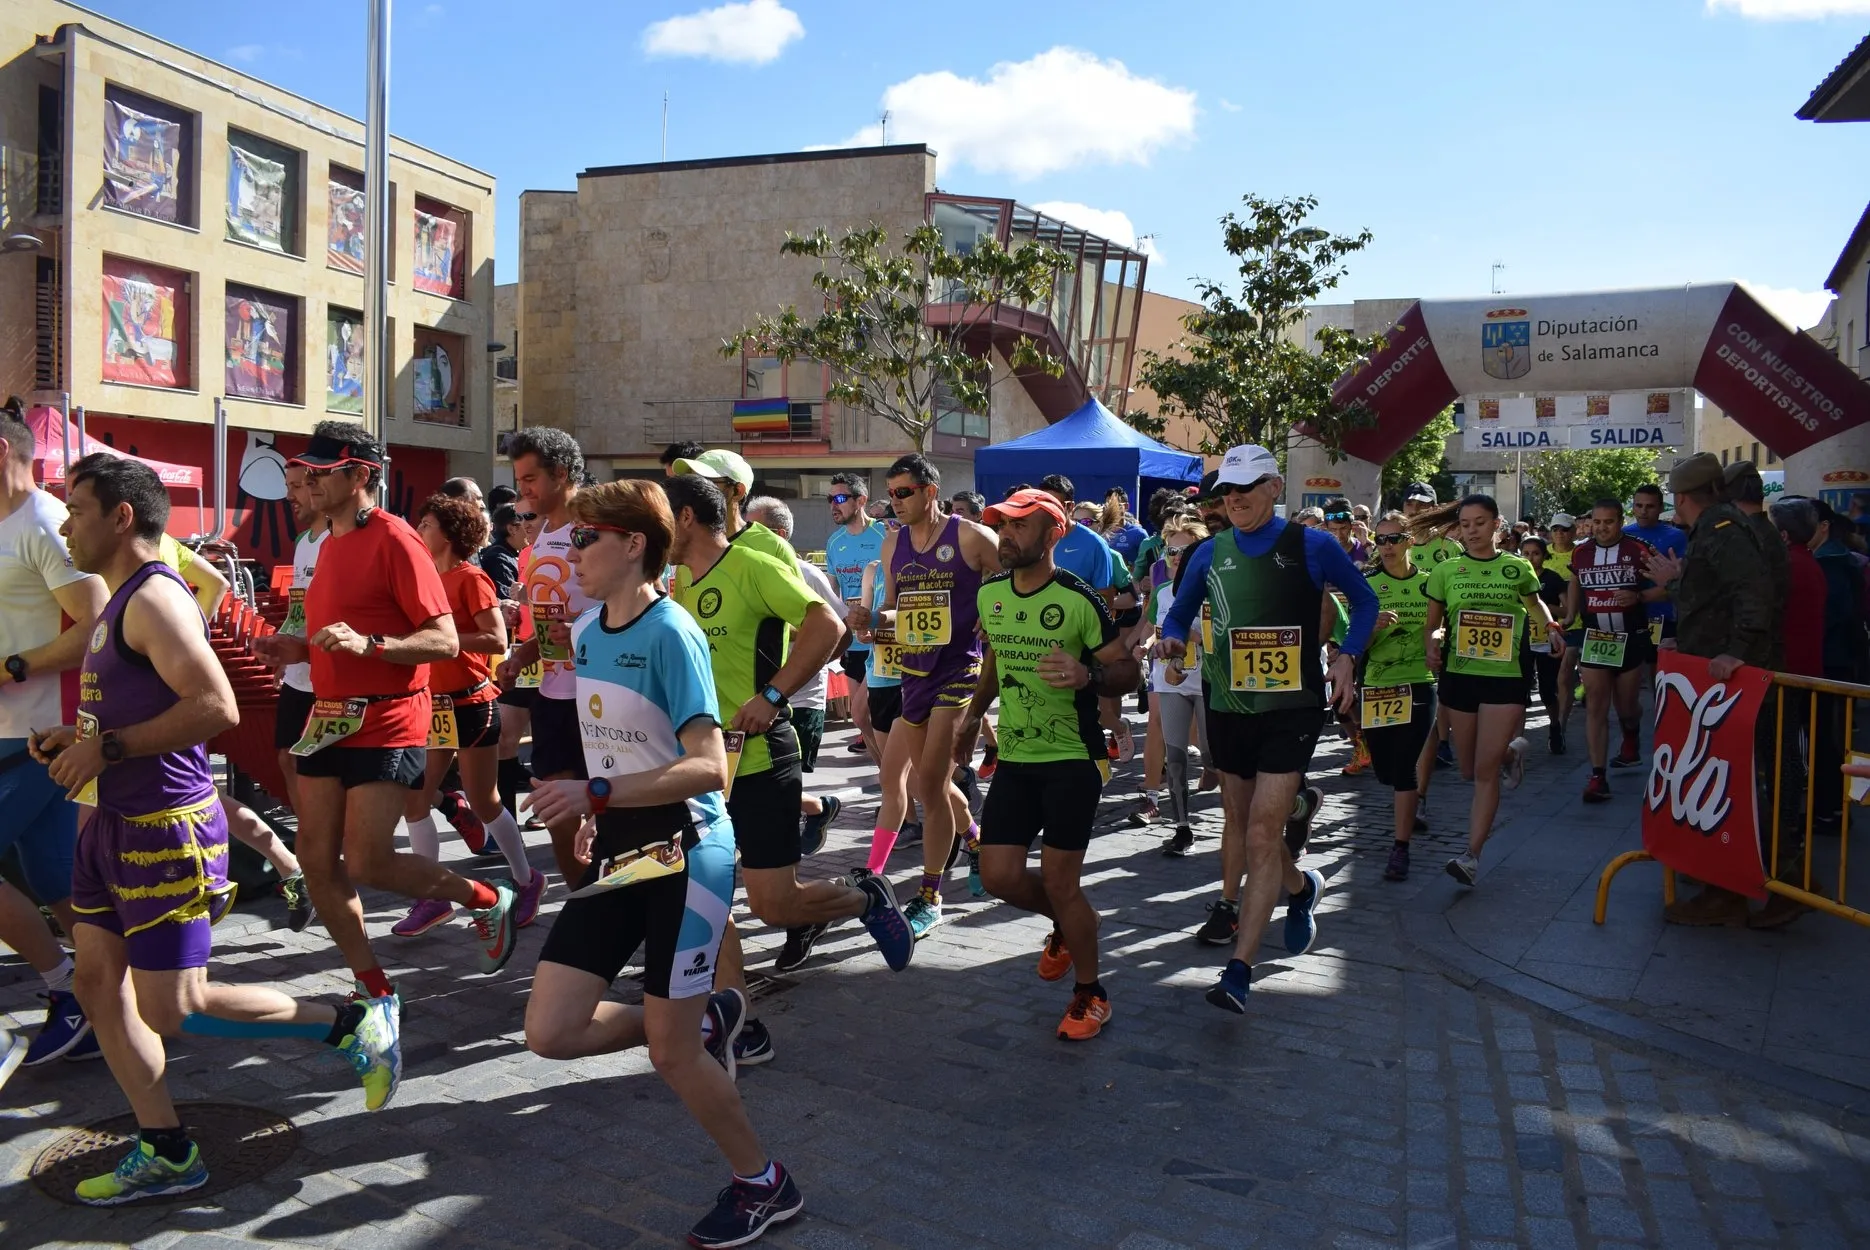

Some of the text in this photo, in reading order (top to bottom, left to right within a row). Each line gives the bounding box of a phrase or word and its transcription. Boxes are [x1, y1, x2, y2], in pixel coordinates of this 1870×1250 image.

[1538, 315, 1638, 339] Diputación
[1538, 343, 1659, 362] de Salamanca
[1366, 336, 1429, 396] DEPORTE
[1727, 323, 1844, 421] CON NUESTROS
[1716, 344, 1820, 431] DEPORTISTAS
[1482, 427, 1664, 447] SALIDA SALIDA
[1461, 592, 1513, 600] CARBAJOSA
[905, 610, 942, 631] 185
[1249, 632, 1277, 640] CROSS
[1468, 628, 1503, 648] 389
[1590, 642, 1618, 657] 402
[1244, 650, 1289, 675] 153
[323, 701, 344, 709] CROSS
[347, 703, 358, 711] 19
[1372, 700, 1403, 717] 172
